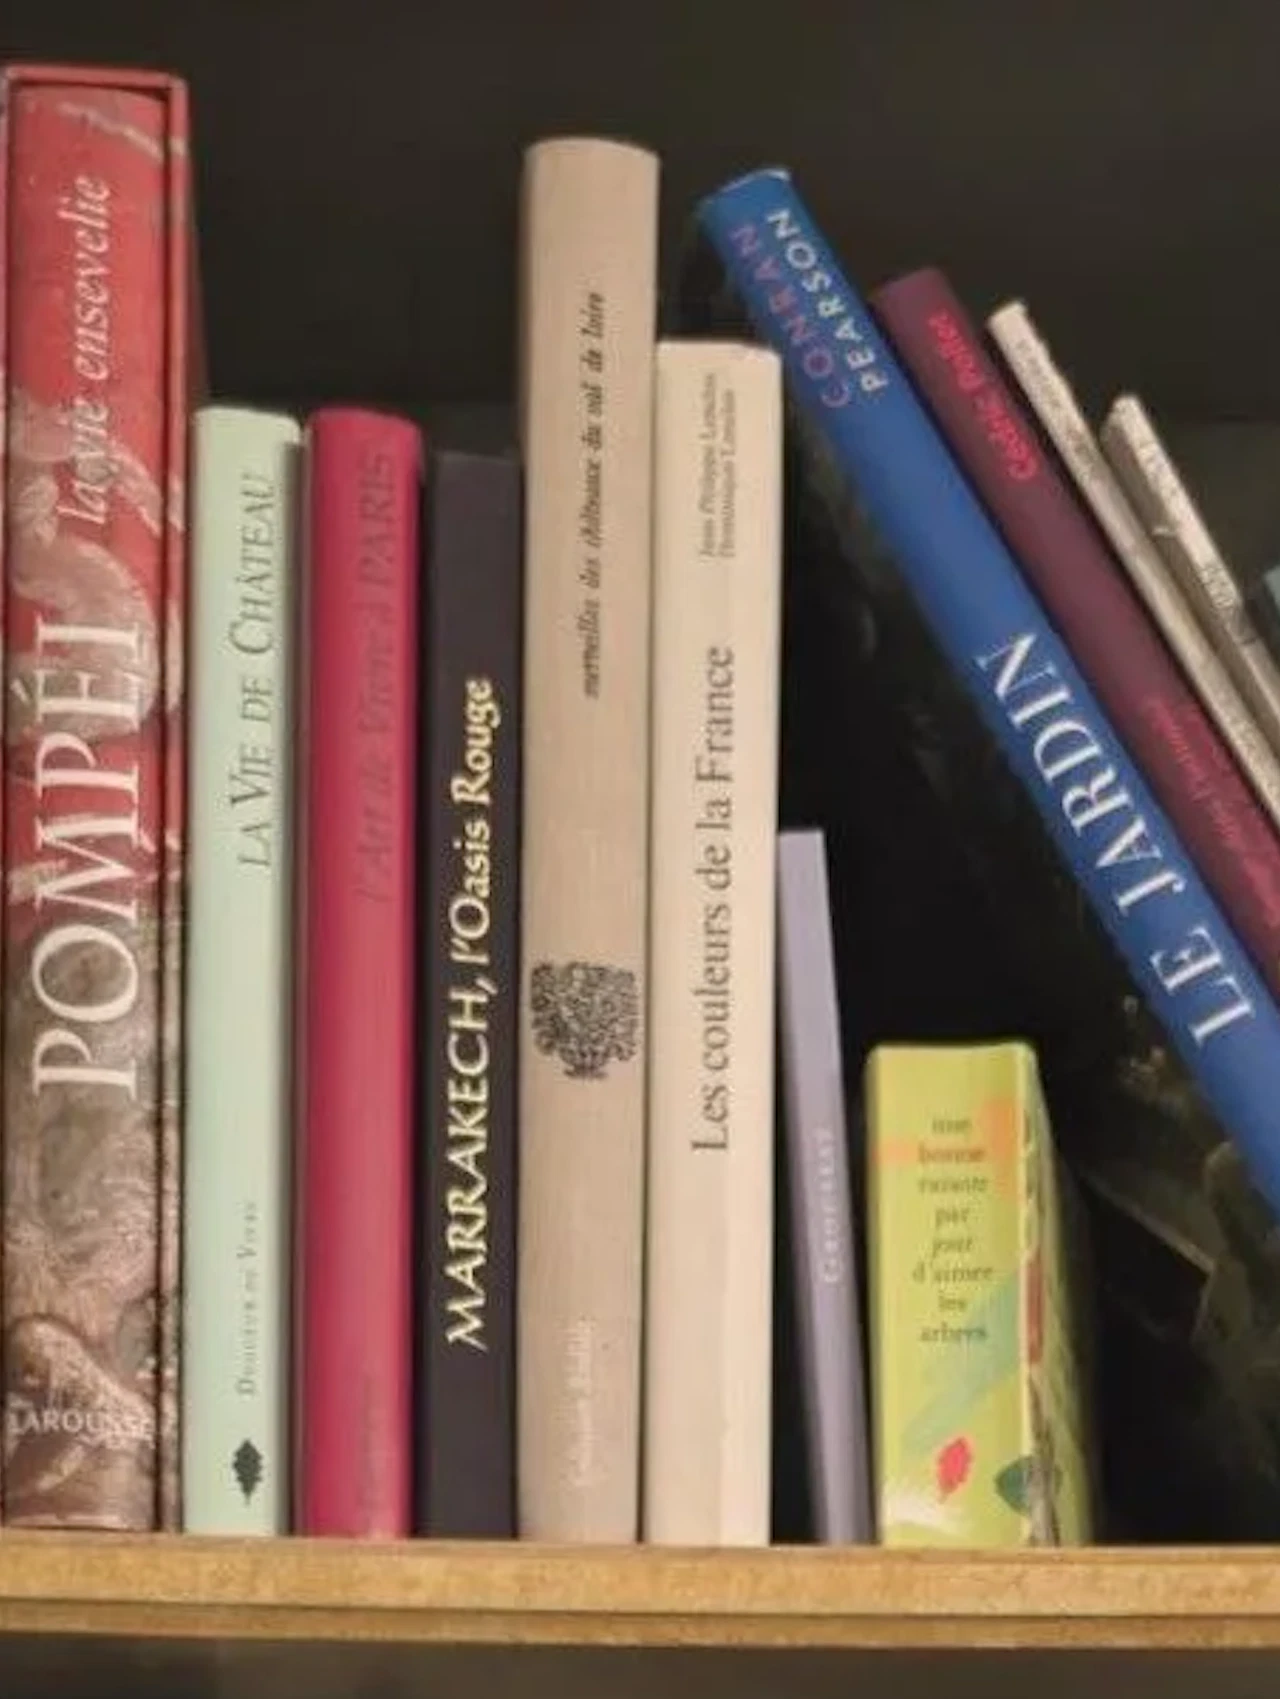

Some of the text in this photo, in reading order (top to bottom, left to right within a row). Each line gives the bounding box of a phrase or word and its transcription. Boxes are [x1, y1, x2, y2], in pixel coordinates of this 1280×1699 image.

[766, 207, 890, 391] PEARSON
[13, 611, 141, 1096] POMPÉI
[225, 471, 276, 868] LA VIE DE CHÂTEAU
[972, 631, 1188, 917] JARDIN
[446, 677, 499, 1352] MARRAKECH, l'Oasis Rouge
[690, 645, 735, 1150] Les couleurs de la France
[1150, 926, 1255, 1042] LE
